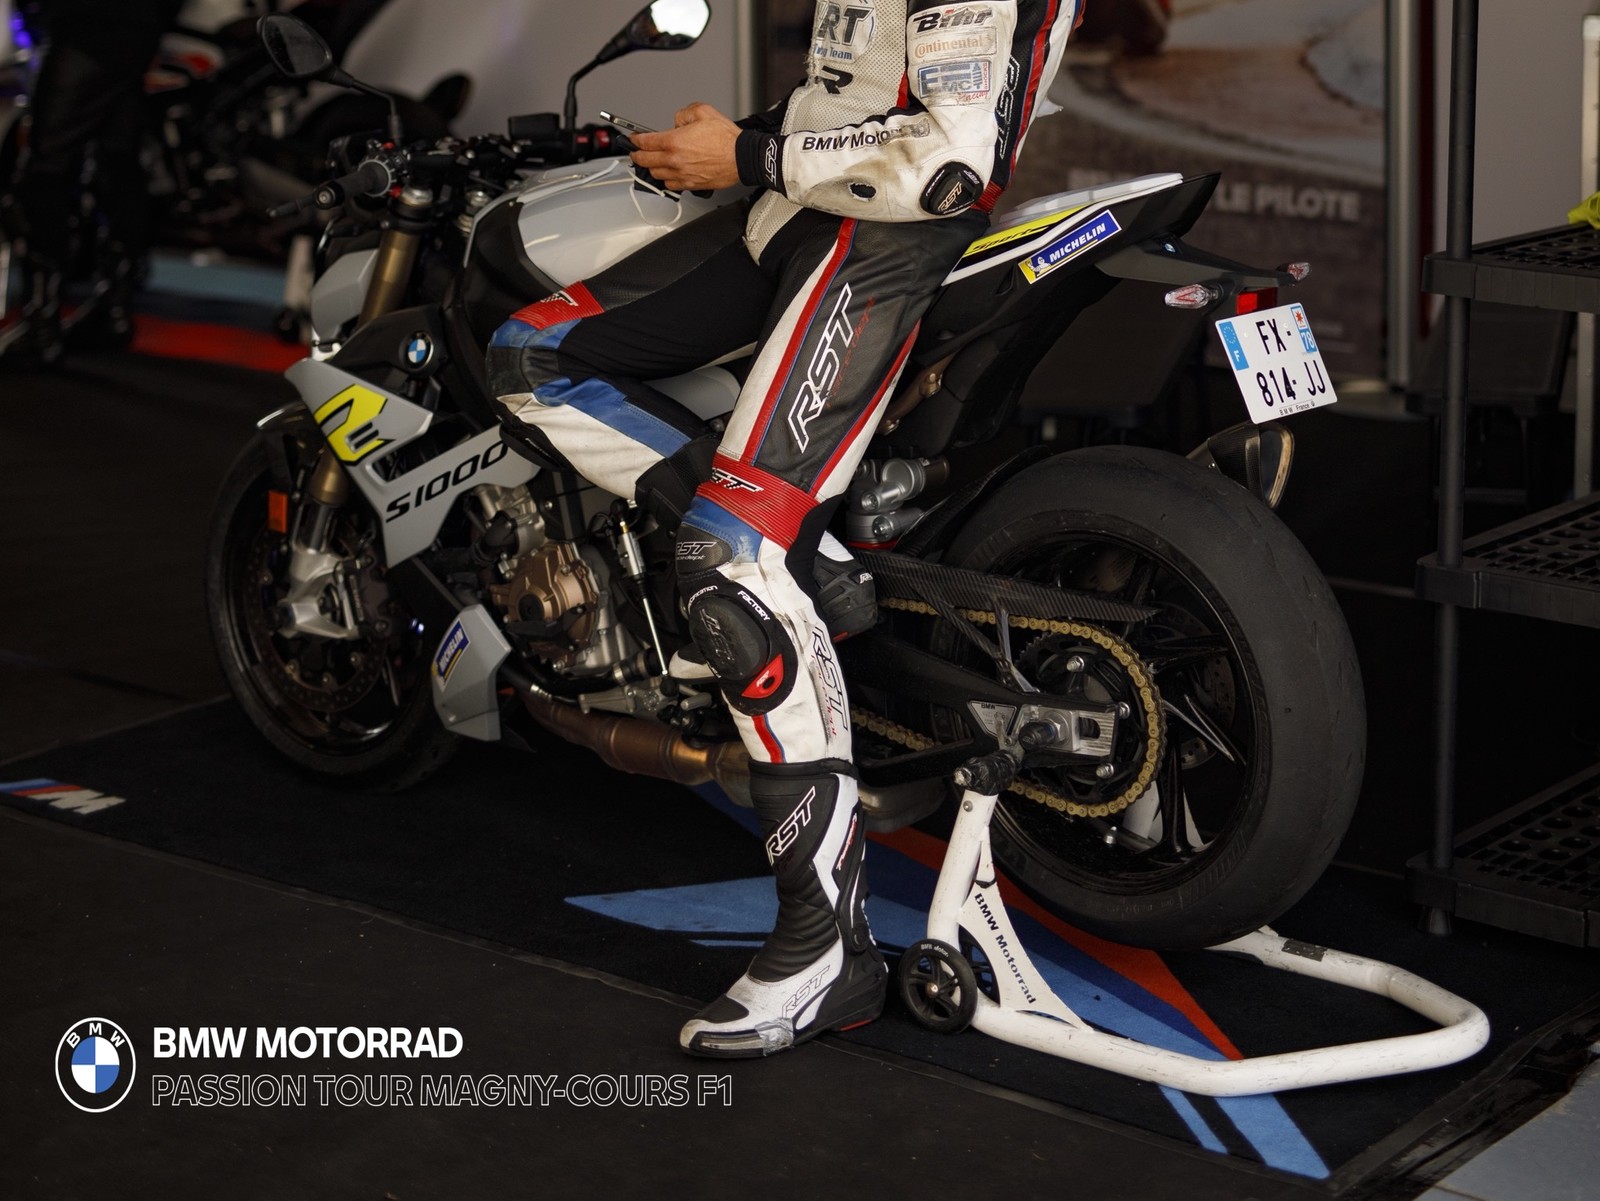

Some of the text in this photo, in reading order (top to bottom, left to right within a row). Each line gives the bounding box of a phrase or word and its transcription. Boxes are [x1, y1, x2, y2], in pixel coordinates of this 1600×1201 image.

[913, 7, 993, 33] Bihr
[830, 47, 853, 60] Team
[915, 35, 982, 59] Continental
[802, 135, 849, 151] BMW
[765, 138, 777, 187] RST
[938, 181, 962, 212] RST
[1255, 185, 1361, 221] PILOTE
[1049, 223, 1107, 263] MICHELIN
[1233, 350, 1240, 362] F
[1301, 331, 1315, 350] 78
[788, 282, 854, 454] RST
[386, 440, 509, 523] S1000
[812, 626, 848, 731] RST
[765, 785, 816, 867] RST
[974, 893, 1037, 1004] BMW Motorrad
[782, 964, 831, 1020] RST
